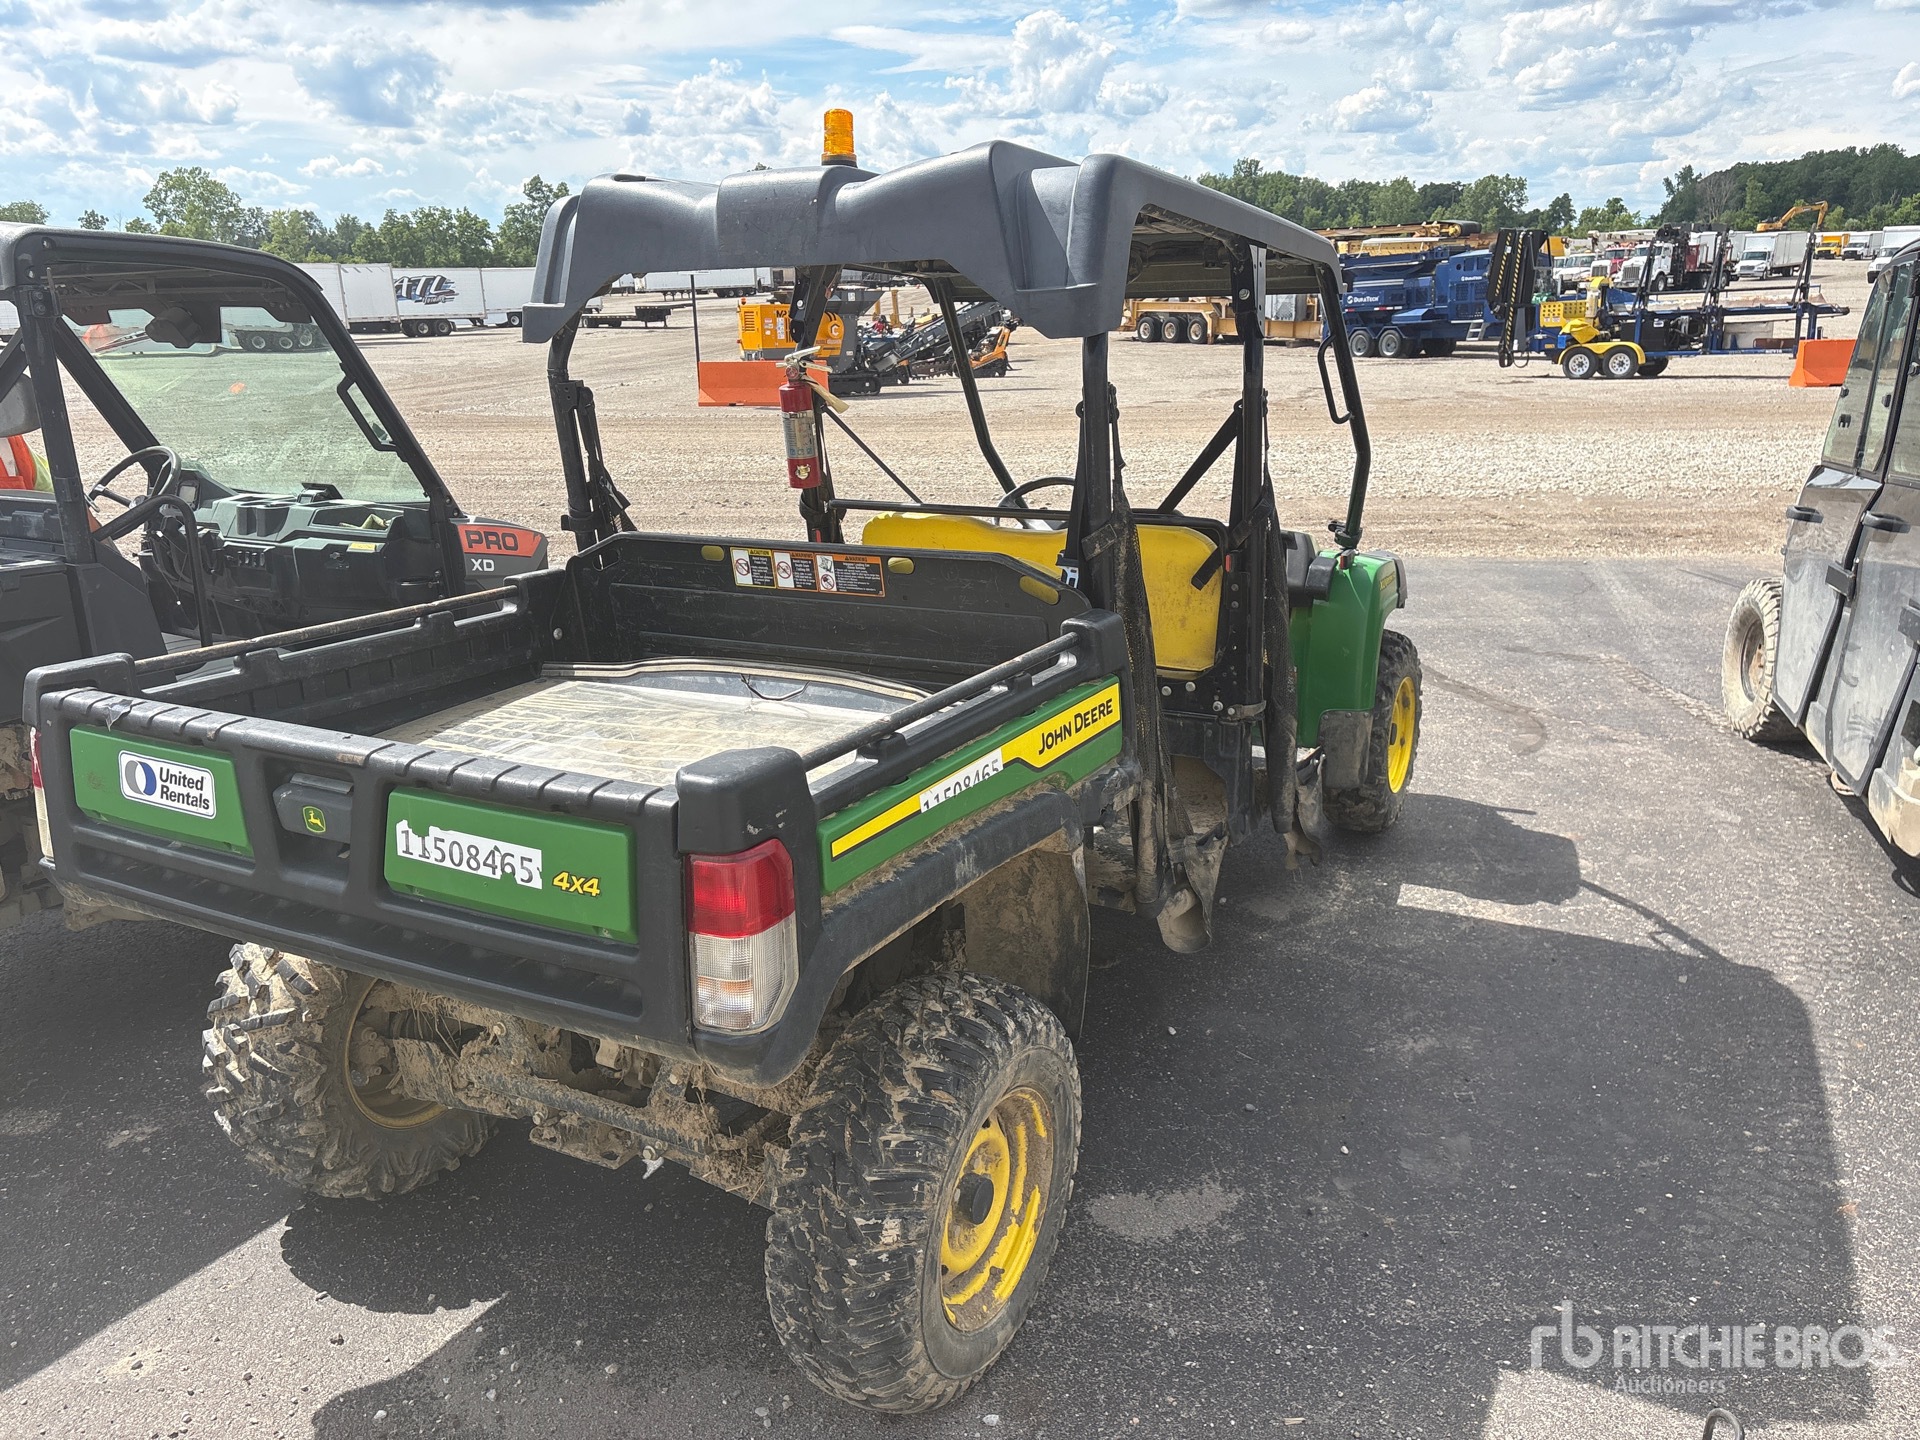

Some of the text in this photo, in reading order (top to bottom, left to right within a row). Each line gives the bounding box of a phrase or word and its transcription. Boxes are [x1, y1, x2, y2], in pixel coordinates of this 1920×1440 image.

[465, 530, 518, 551] PRO
[470, 558, 495, 572] XD
[1038, 698, 1114, 756] JOHN DEERE
[159, 766, 204, 792] United
[160, 784, 210, 810] Rentals
[400, 829, 534, 884] 11508465
